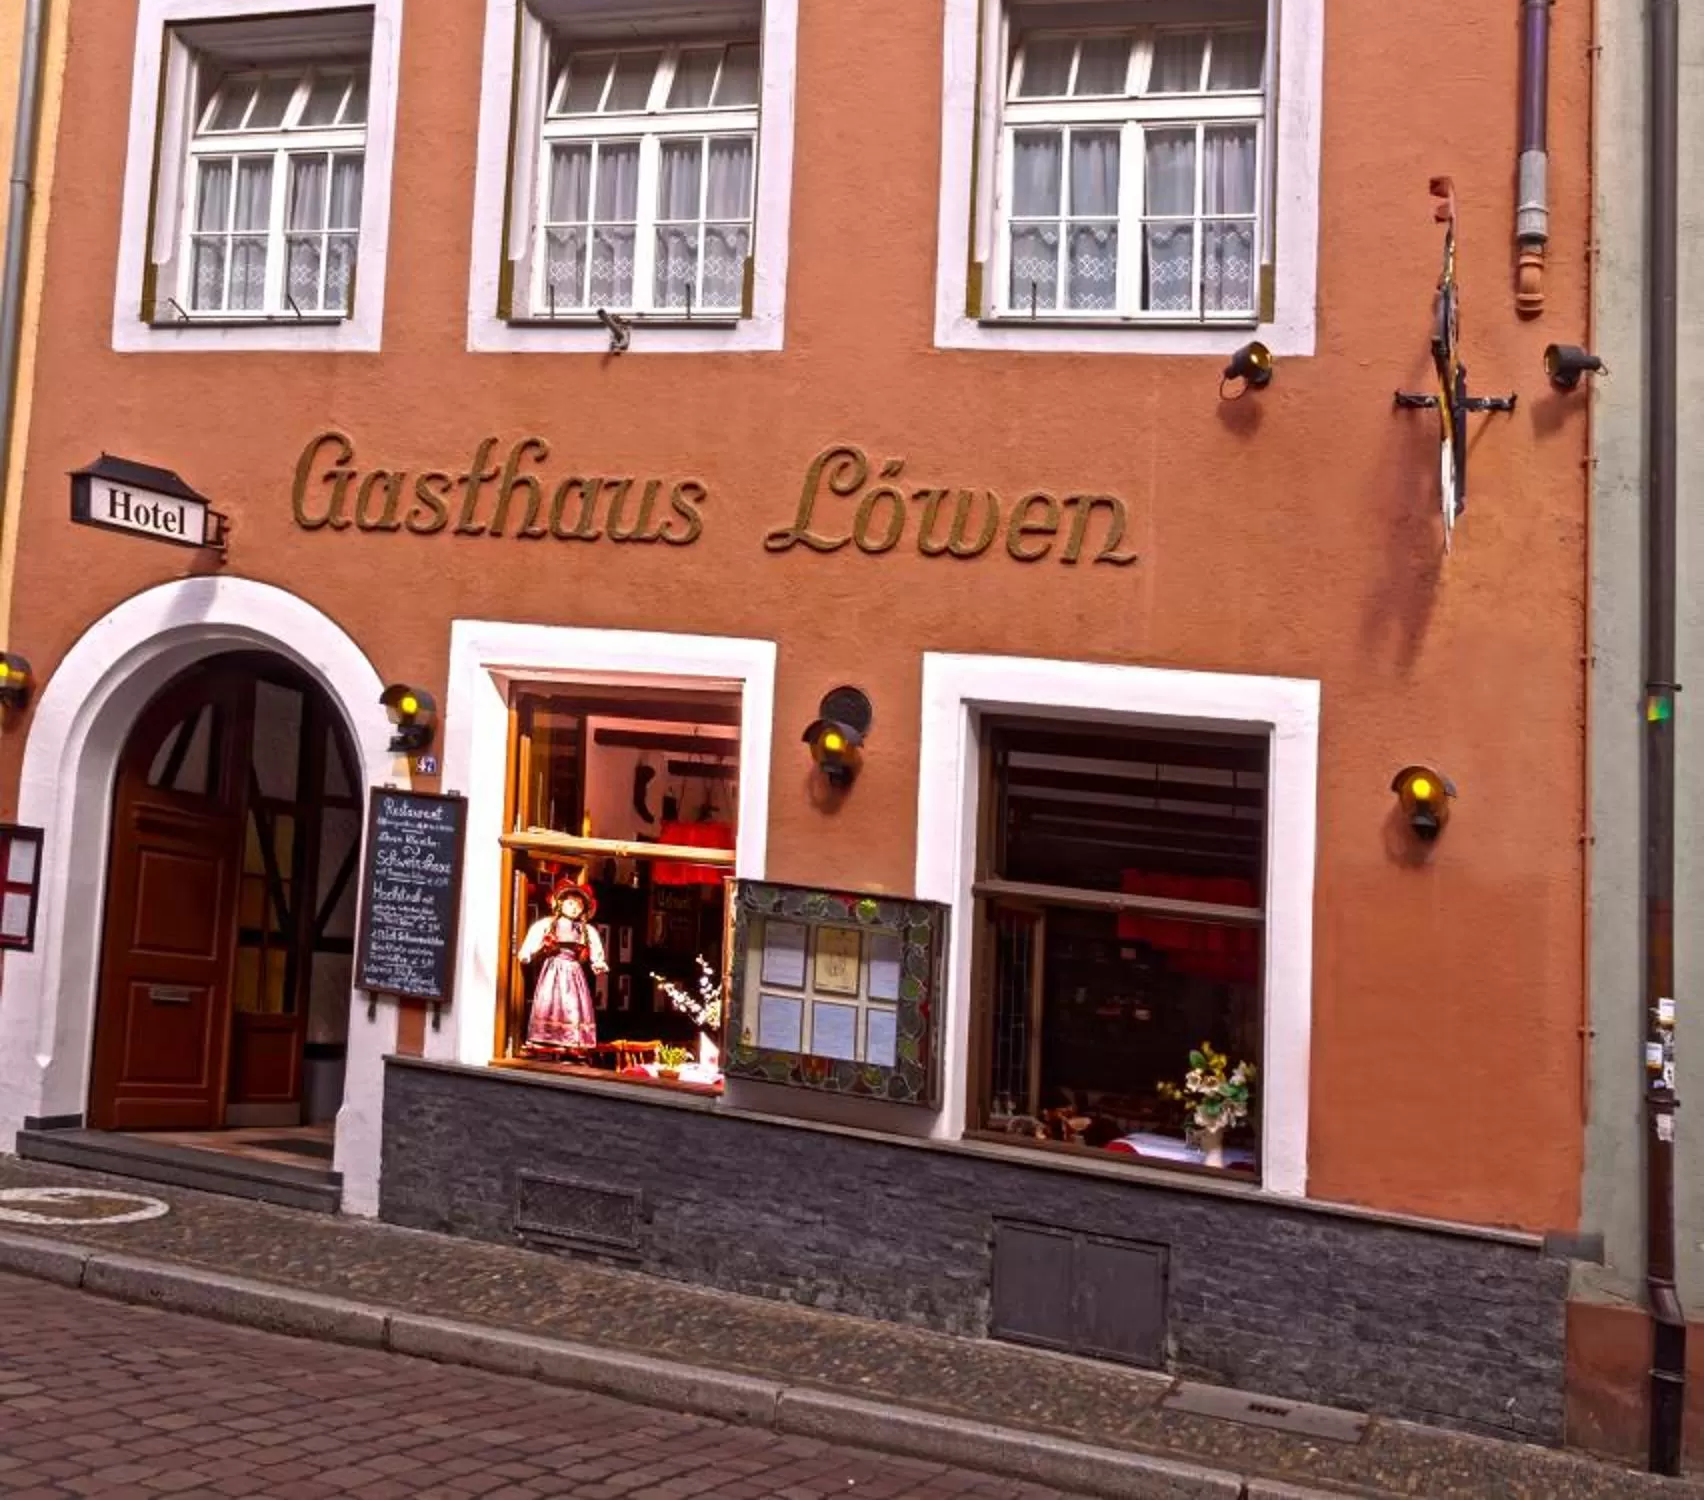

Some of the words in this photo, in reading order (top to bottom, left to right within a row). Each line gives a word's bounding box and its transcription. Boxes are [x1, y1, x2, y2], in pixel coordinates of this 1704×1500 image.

[108, 487, 186, 536] Hotel
[292, 431, 708, 545] Gasthaus
[764, 445, 1138, 566] Löwen
